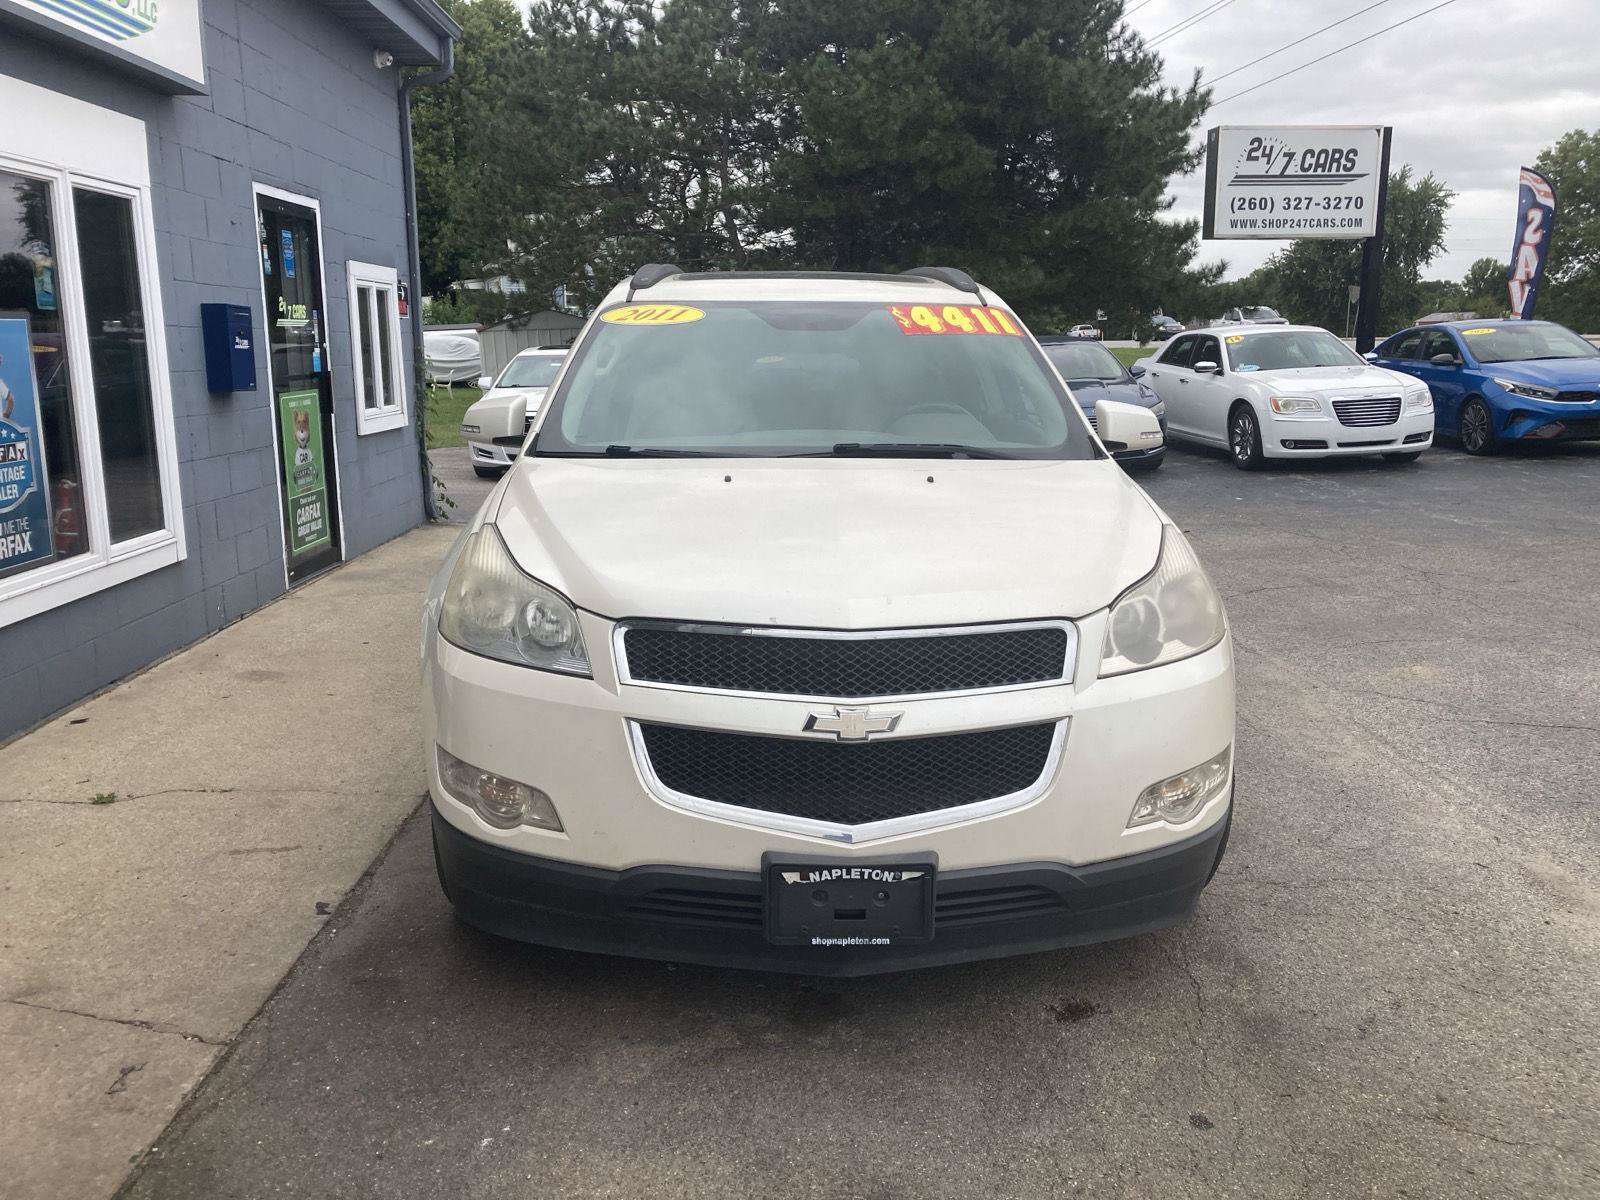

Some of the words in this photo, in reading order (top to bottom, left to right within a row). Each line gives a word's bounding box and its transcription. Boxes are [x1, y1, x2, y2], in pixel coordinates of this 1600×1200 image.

[1246, 137, 1296, 175] 24/7
[1300, 148, 1359, 173] CARS
[1230, 197, 1275, 213] (260)
[1282, 196, 1364, 211] 327-3270
[1230, 217, 1363, 229] WWW.SHOP247CARS.COM
[614, 308, 689, 321] 2011
[891, 305, 1022, 334] $4411
[296, 502, 321, 525] CARFAX
[15, 516, 29, 531] THE
[809, 868, 894, 883] NAPLETON
[811, 936, 890, 947] shopnapleton.com
